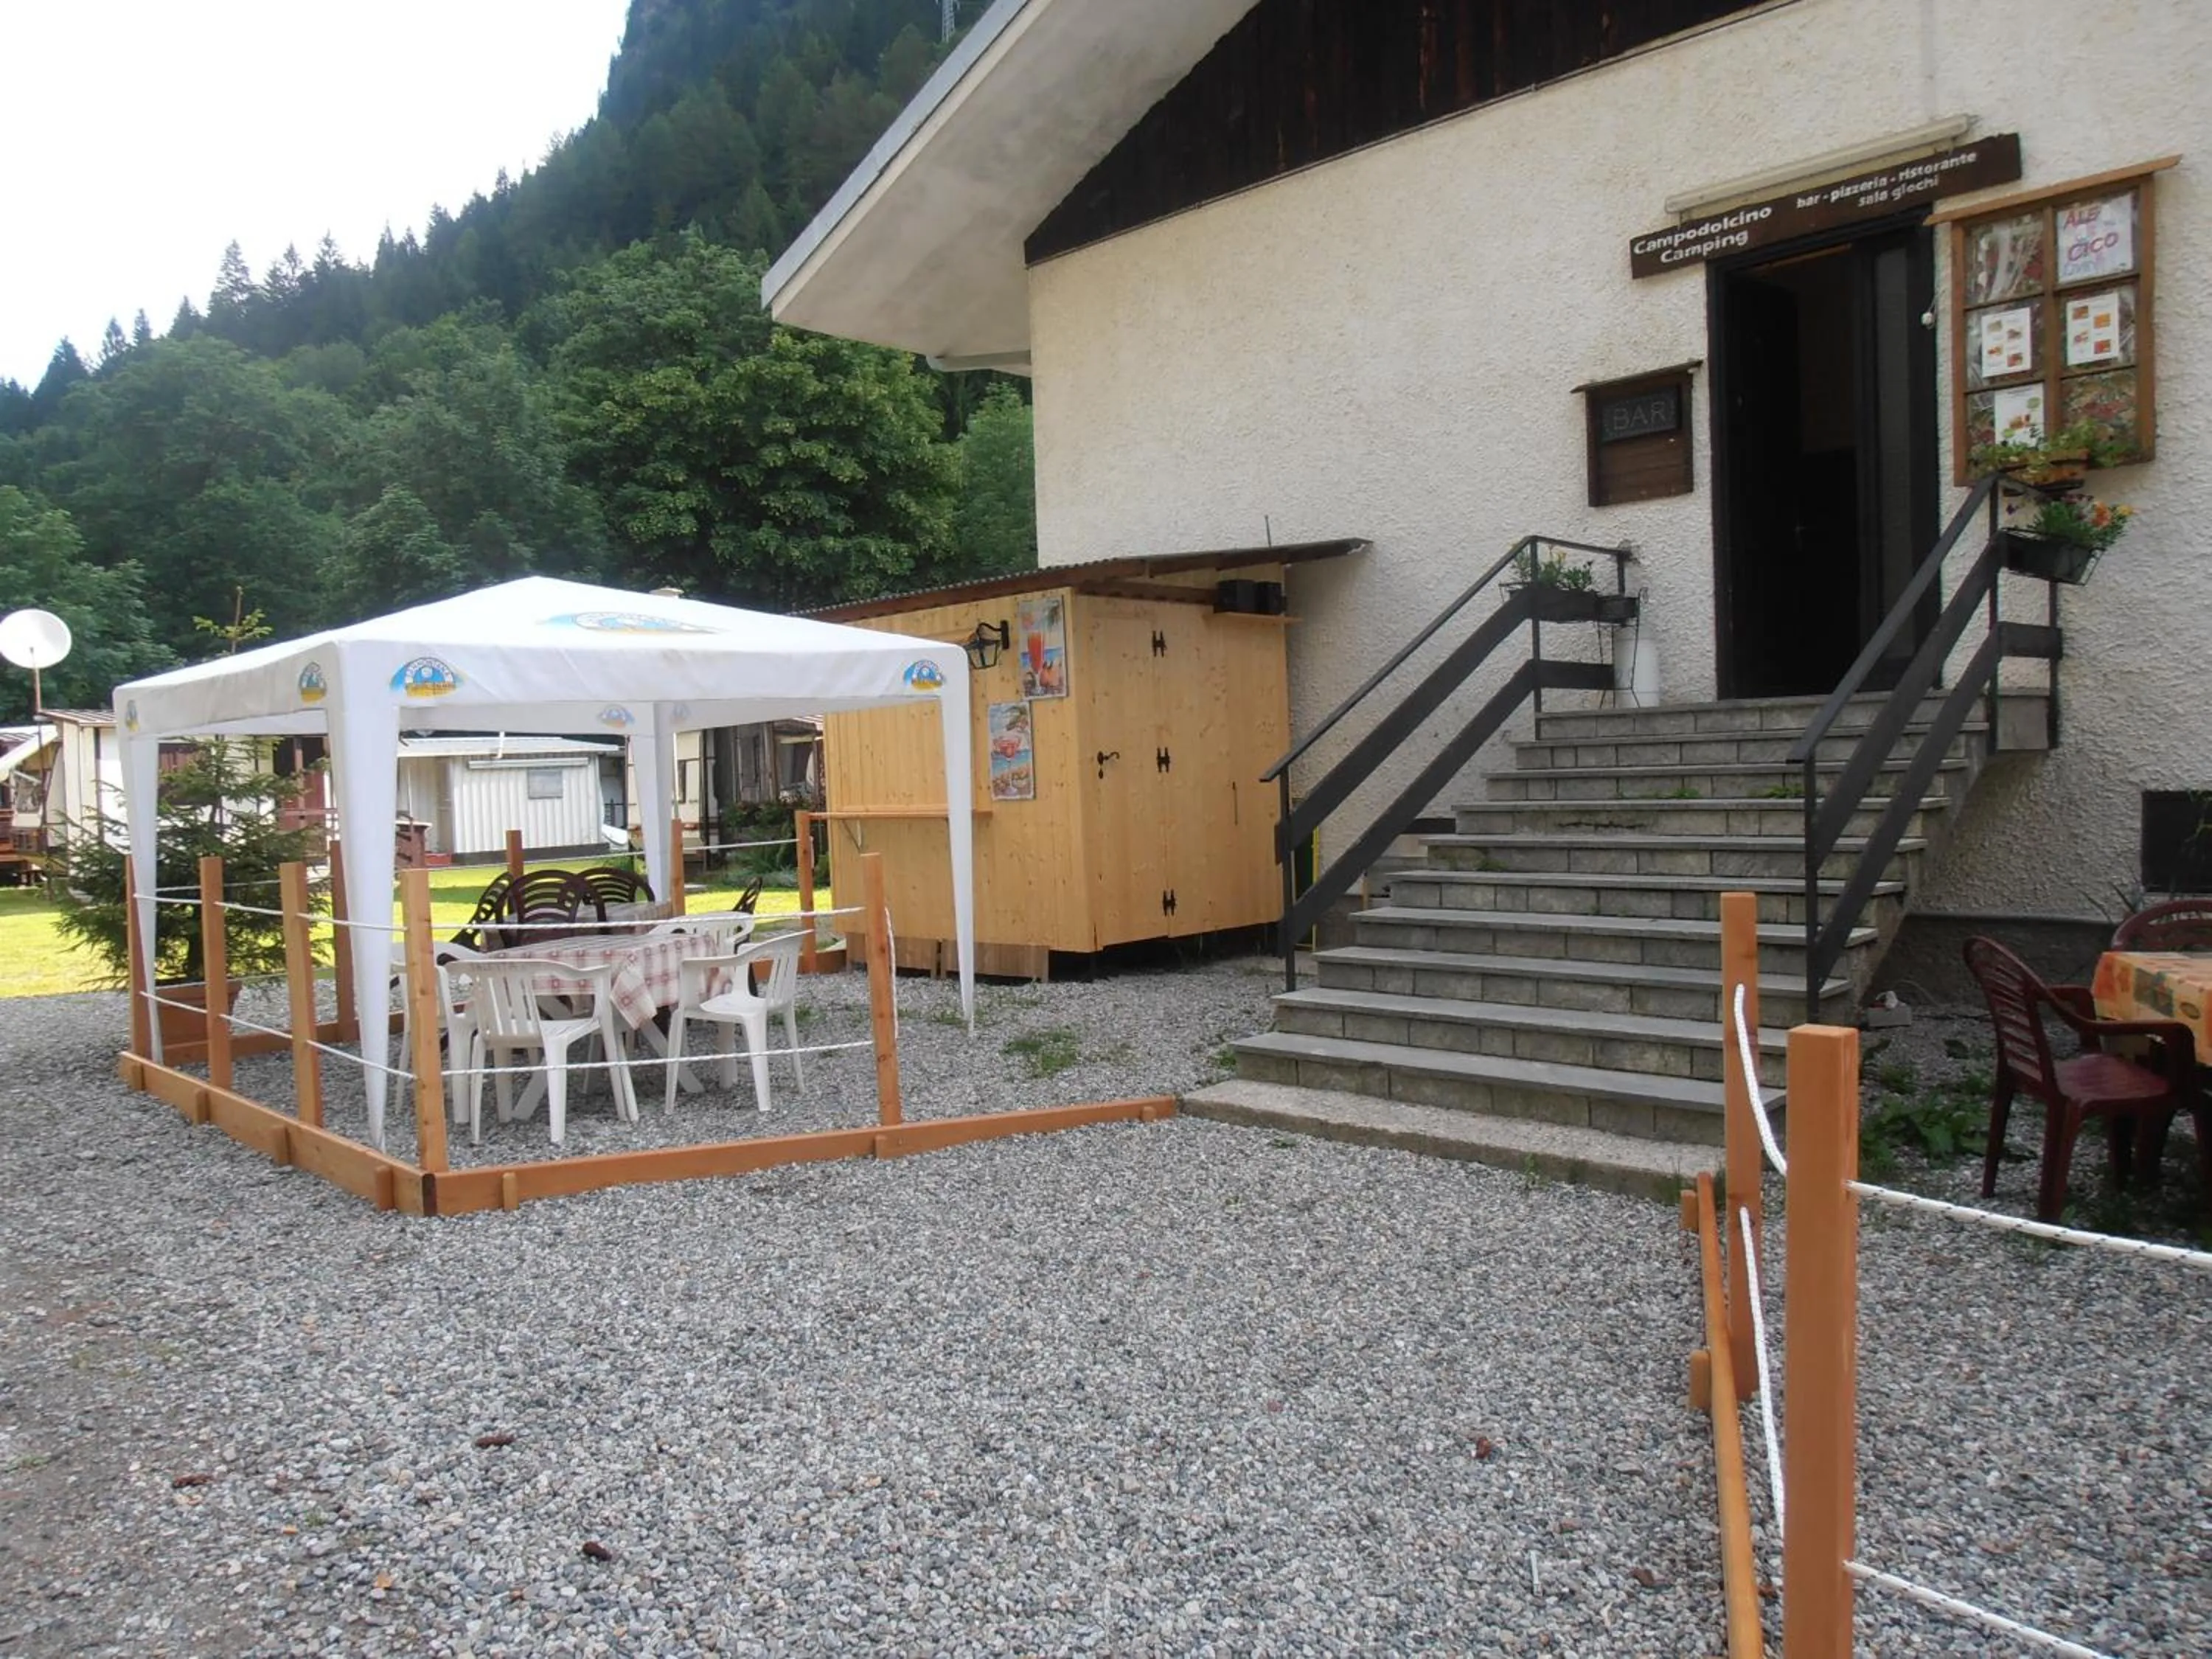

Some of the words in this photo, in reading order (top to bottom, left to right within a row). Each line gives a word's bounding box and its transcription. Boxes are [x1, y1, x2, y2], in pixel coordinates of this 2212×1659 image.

[1796, 193, 1820, 209] bar
[1830, 176, 1888, 203] pizzeria
[1899, 152, 1978, 181] ristorante
[1858, 189, 1888, 207] sala
[1891, 175, 1939, 201] giochi
[1633, 206, 1773, 254] Campodolcino
[1660, 230, 1750, 263] Camping
[1613, 401, 1666, 431] BAR
